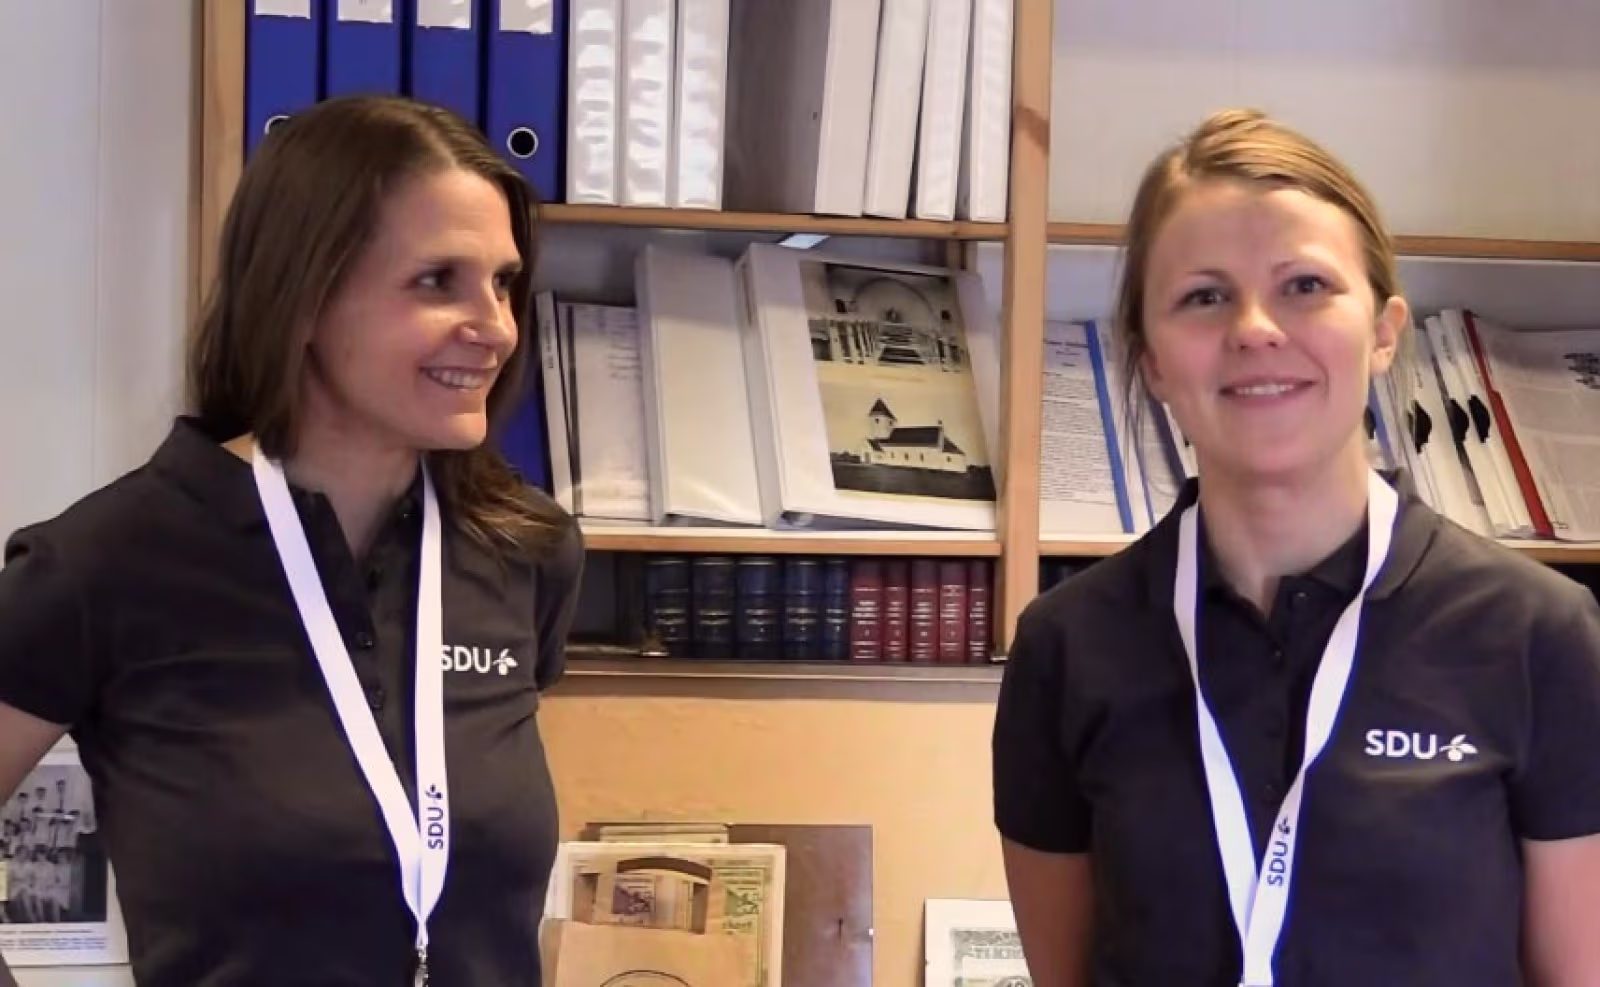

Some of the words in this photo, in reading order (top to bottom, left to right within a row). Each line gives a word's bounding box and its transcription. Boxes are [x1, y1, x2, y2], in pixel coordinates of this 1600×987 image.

[440, 644, 491, 673] SDU
[1364, 728, 1437, 759] SDU
[427, 806, 444, 850] SDU
[1267, 840, 1289, 887] SDU
